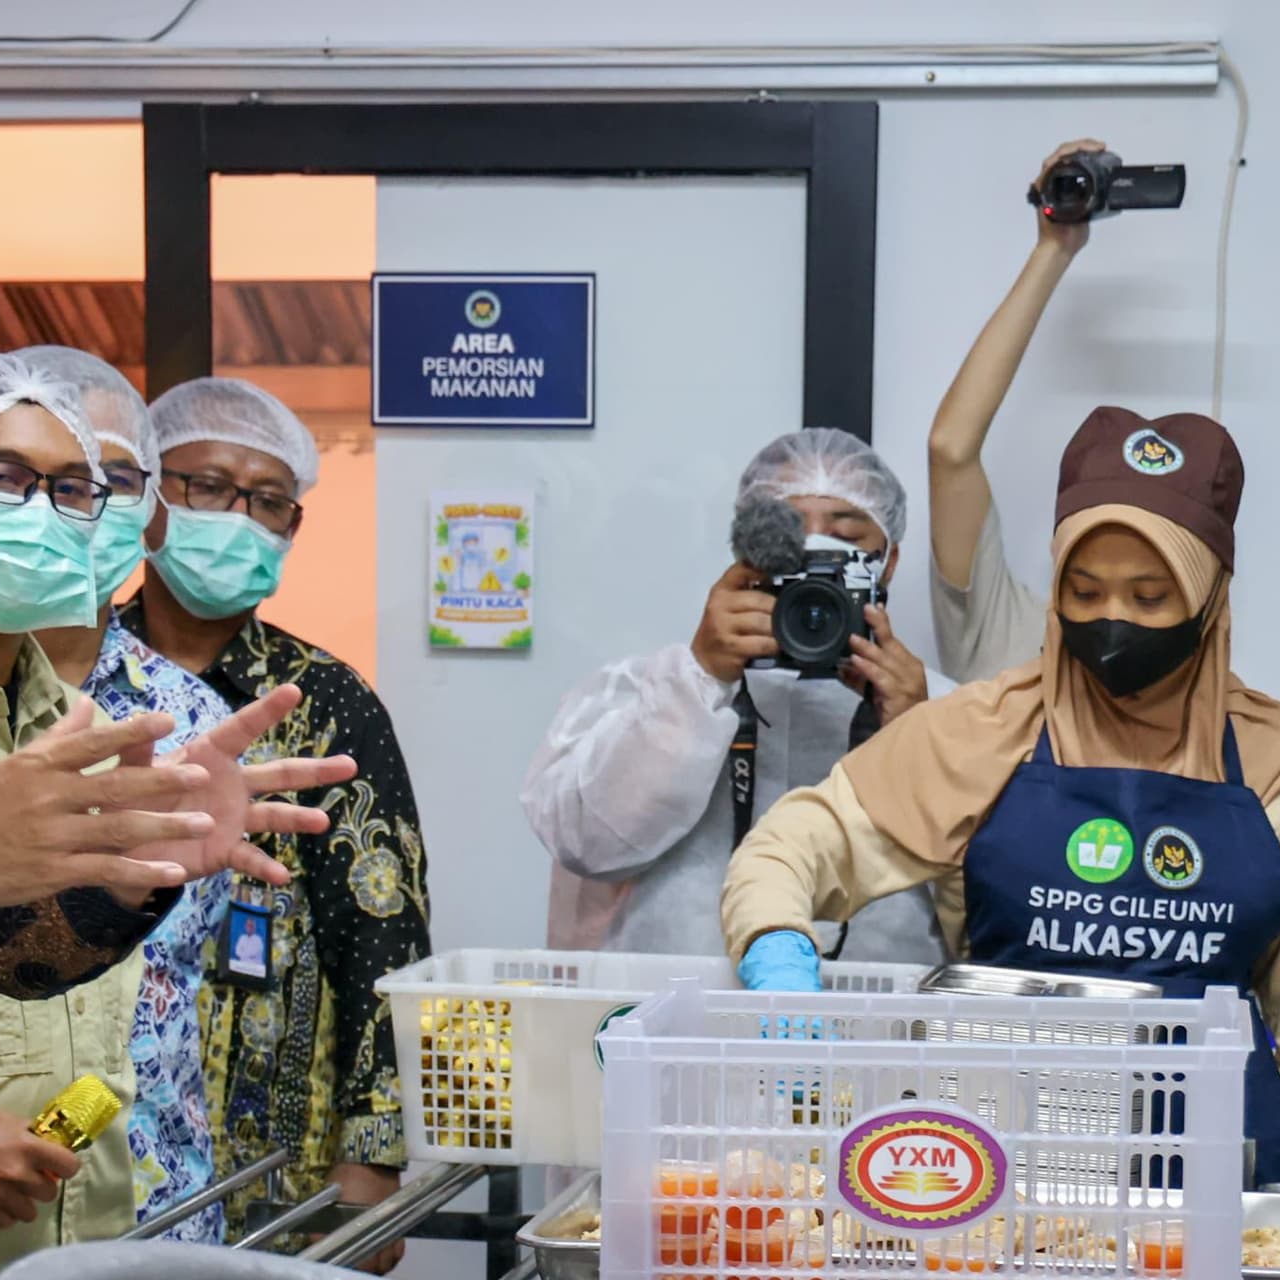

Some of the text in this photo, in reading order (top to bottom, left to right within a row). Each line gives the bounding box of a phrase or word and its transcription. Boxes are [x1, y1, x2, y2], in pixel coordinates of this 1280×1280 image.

[452, 333, 515, 354] AREA
[422, 357, 544, 378] PEMORSIAN
[431, 378, 535, 398] MAKANAN
[1028, 886, 1234, 924] SPPG CILEUNYI
[1026, 917, 1226, 964] ALKASYAF
[888, 1146, 956, 1168] YXM
